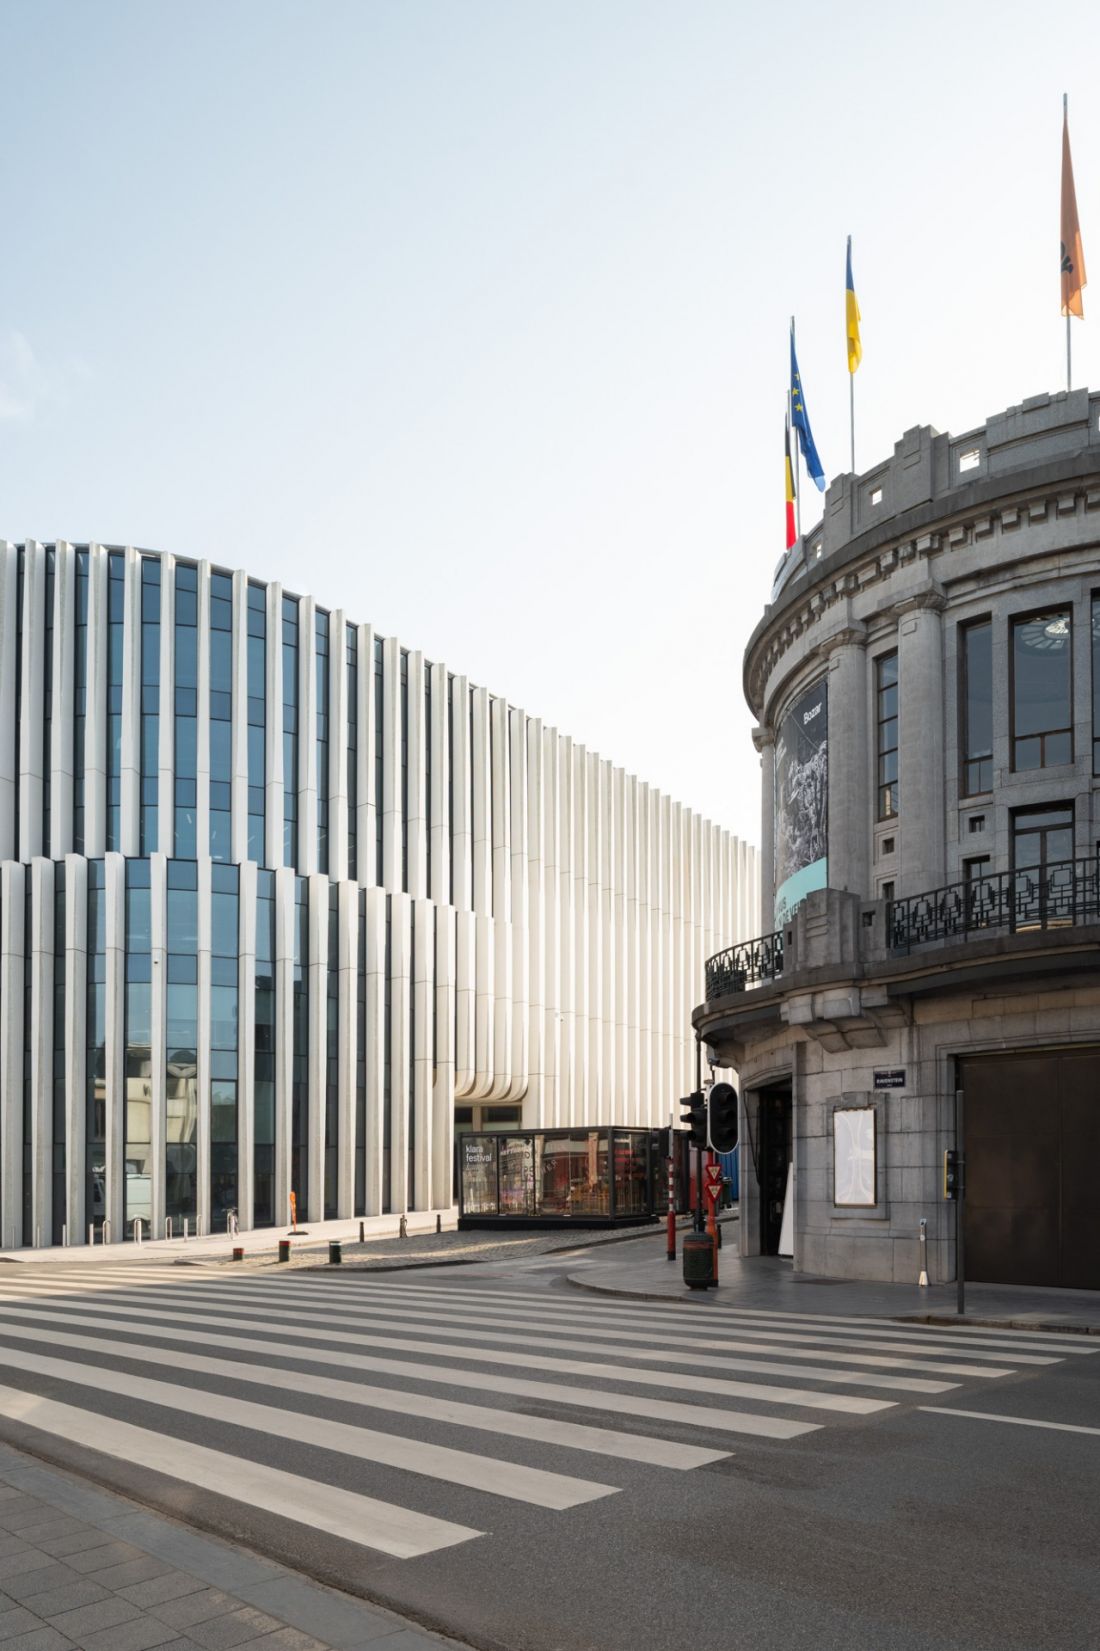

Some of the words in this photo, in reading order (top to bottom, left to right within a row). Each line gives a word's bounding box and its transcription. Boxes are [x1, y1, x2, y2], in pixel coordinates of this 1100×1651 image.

[803, 702, 822, 725] Bozar
[465, 1144, 484, 1153] klara
[466, 1153, 492, 1162] festival
